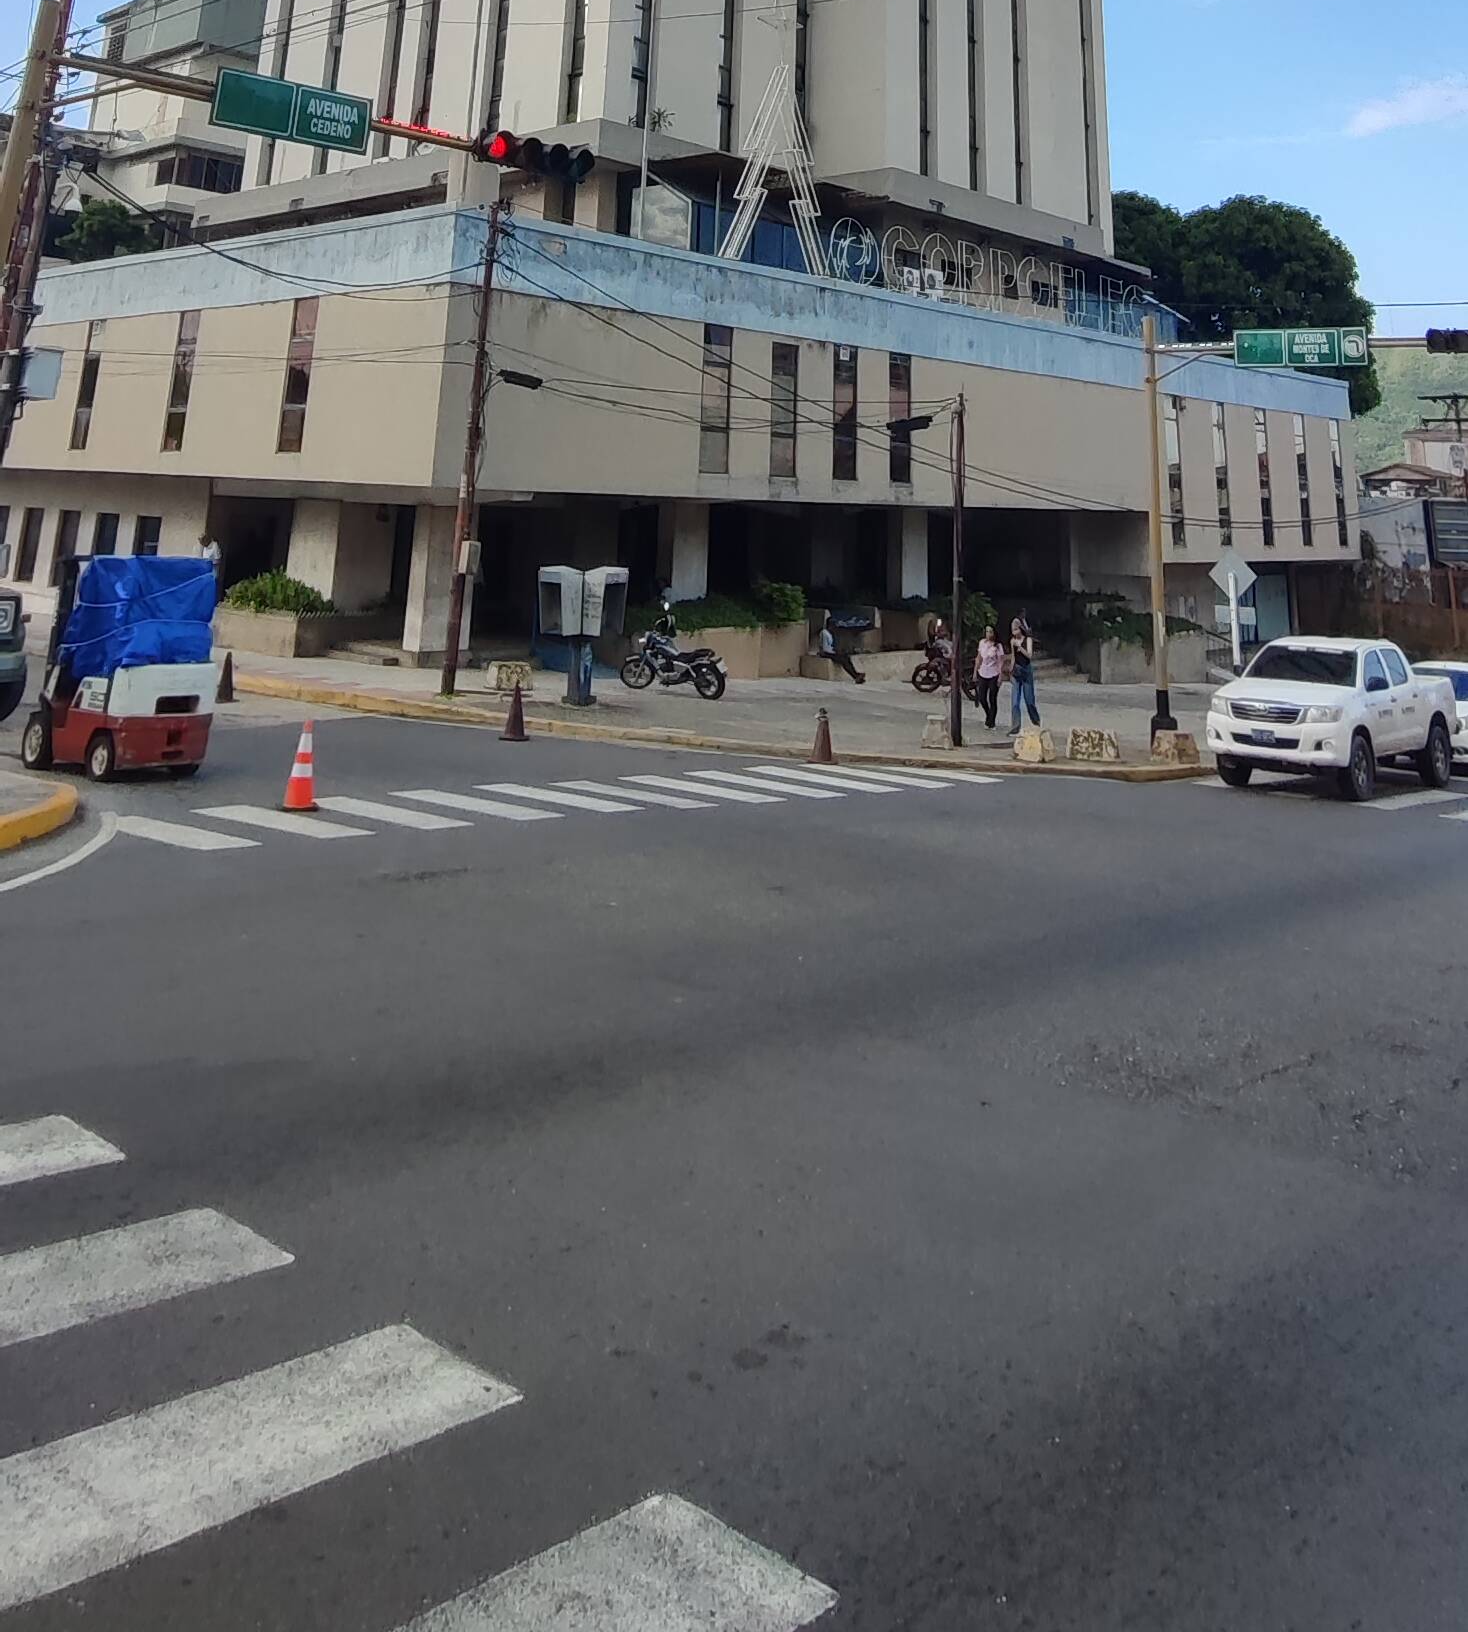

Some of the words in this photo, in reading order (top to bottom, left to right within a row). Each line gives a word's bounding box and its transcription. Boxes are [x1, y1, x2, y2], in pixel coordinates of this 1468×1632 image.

[307, 97, 358, 124] AVENIDA
[310, 117, 352, 139] CEDEÑO
[1294, 333, 1328, 344] AVENIDA
